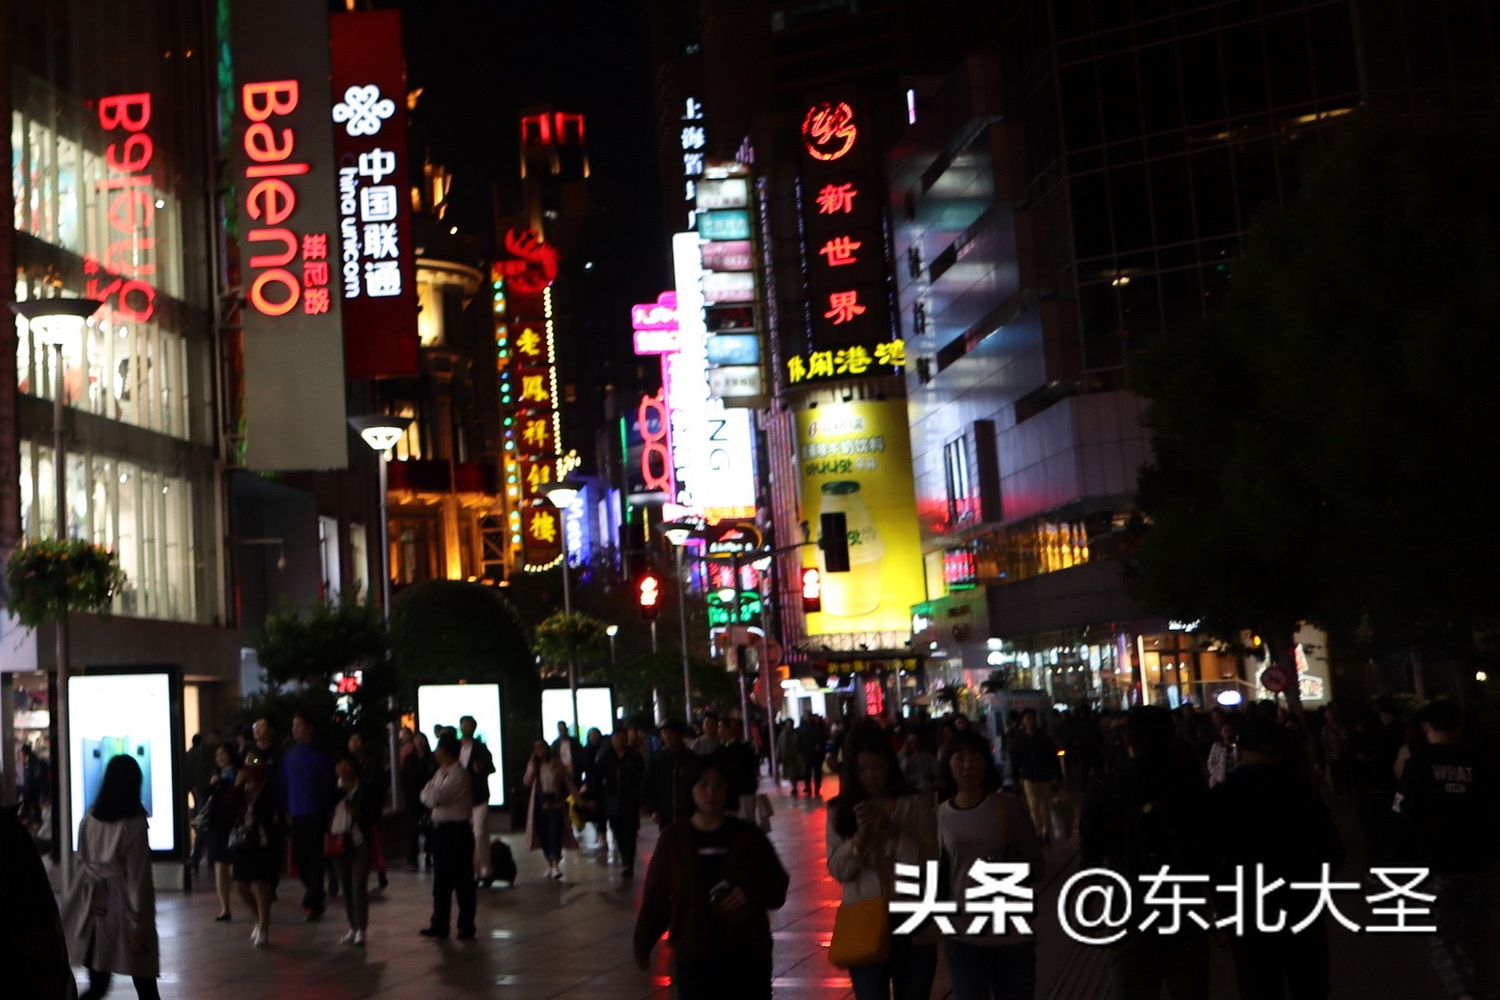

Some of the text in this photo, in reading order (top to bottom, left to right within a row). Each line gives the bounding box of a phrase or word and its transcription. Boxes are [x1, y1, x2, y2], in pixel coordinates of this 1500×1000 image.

[243, 79, 310, 316] Baleno
[341, 217, 362, 299] unicom
[358, 147, 402, 298] 中国联通
[816, 183, 866, 325] 新世界
[302, 233, 331, 315] 班尼路
